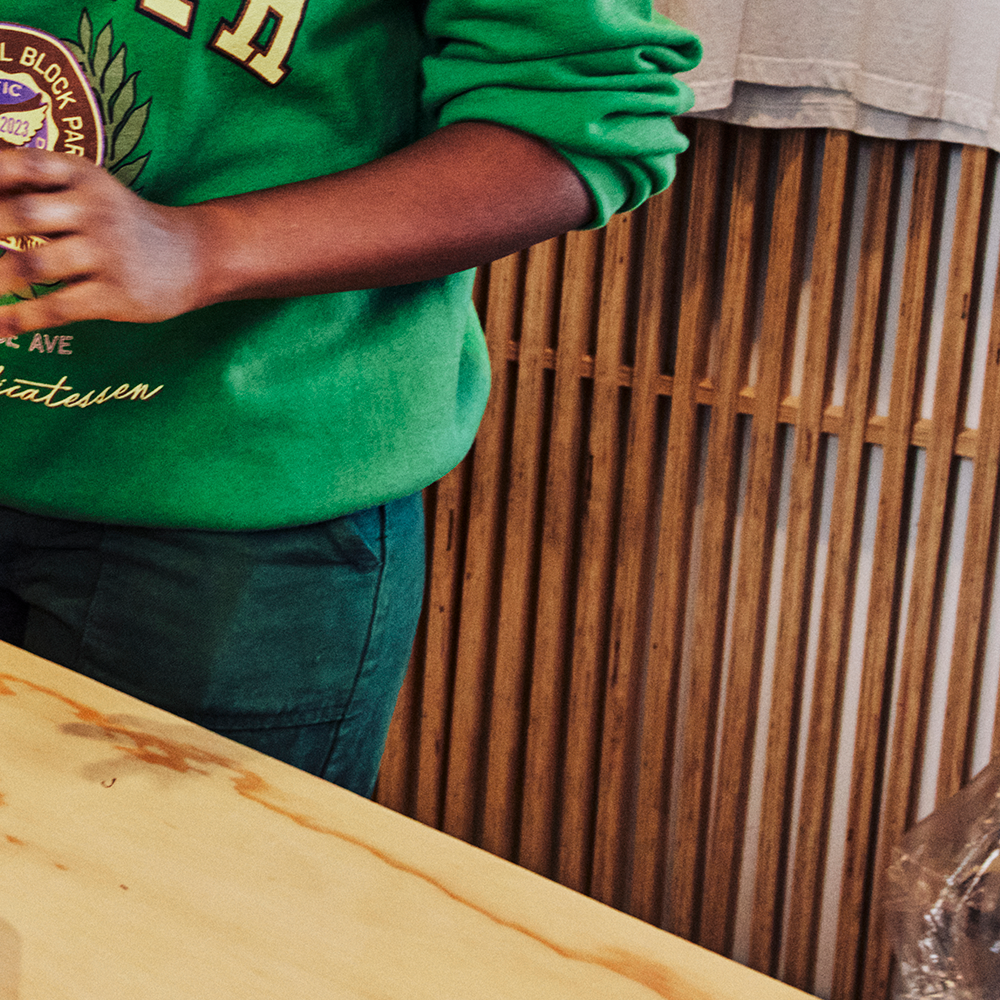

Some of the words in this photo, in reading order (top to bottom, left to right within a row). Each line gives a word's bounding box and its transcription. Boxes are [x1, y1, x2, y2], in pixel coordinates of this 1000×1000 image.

[19, 45, 76, 110] BLOCK
[0, 116, 29, 137] 2023
[28, 333, 74, 356] AVE
